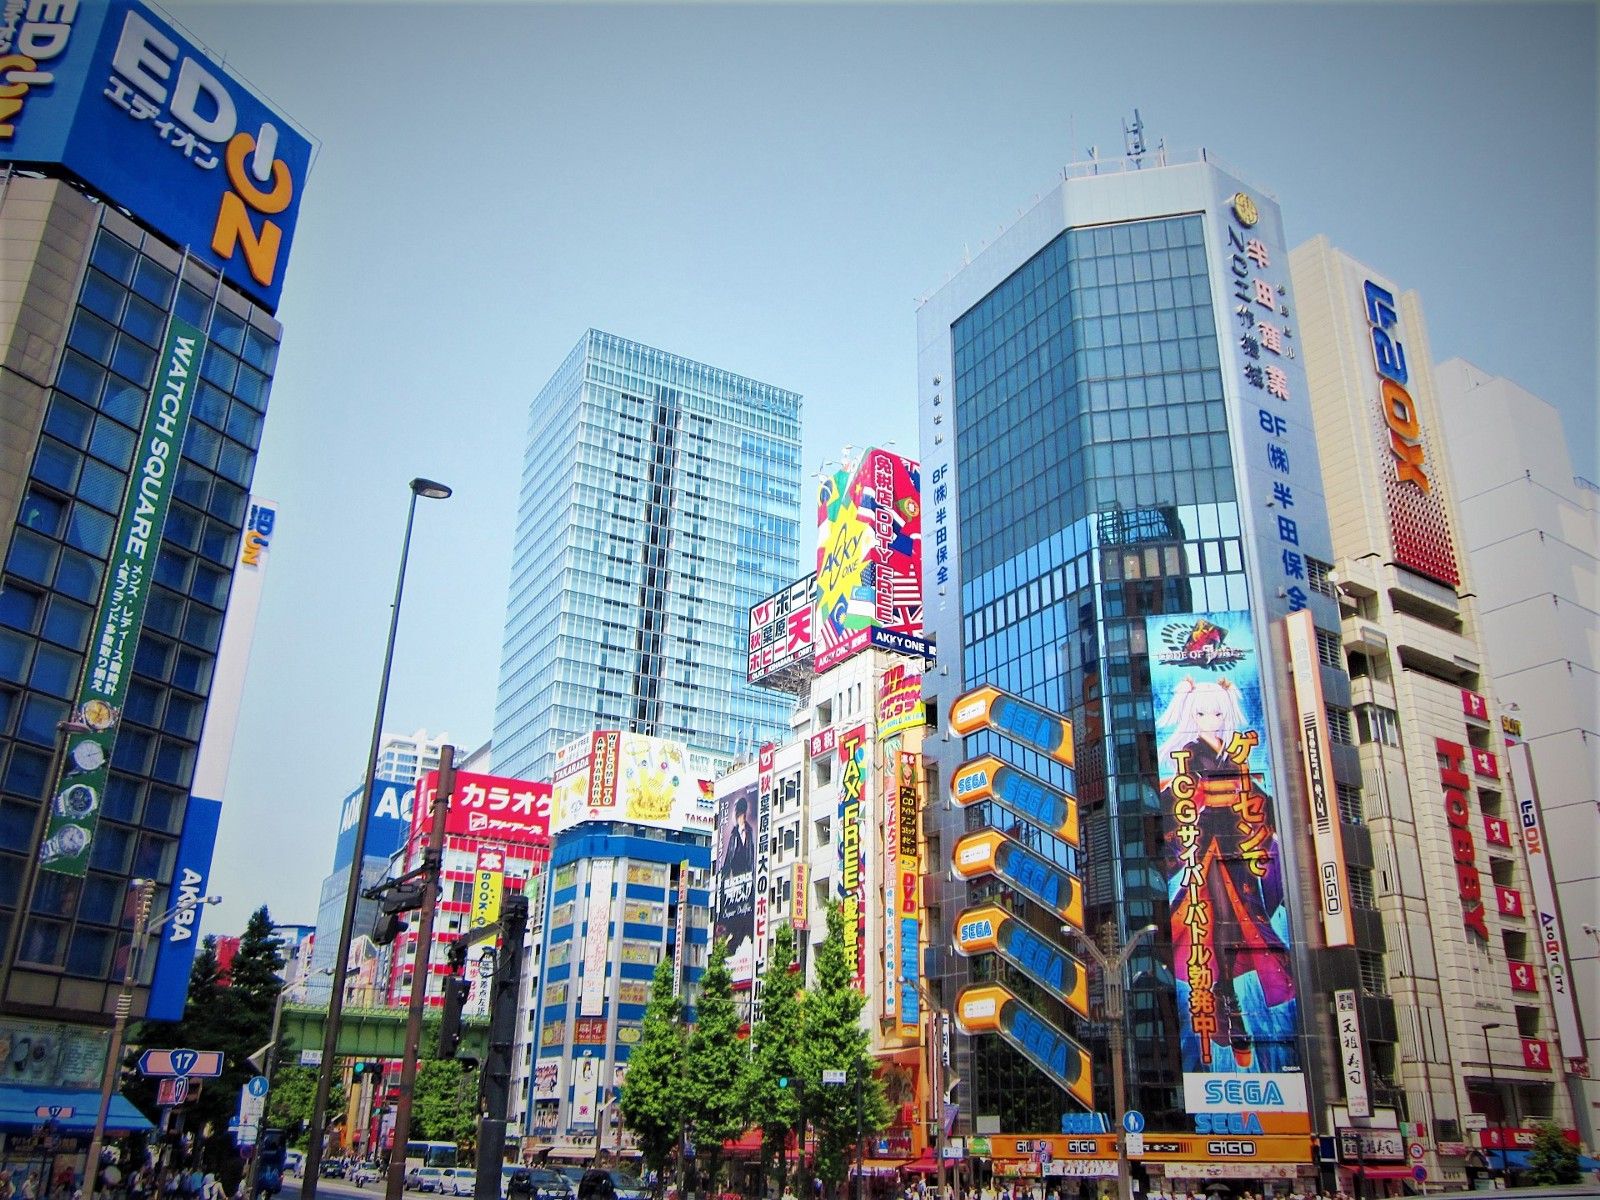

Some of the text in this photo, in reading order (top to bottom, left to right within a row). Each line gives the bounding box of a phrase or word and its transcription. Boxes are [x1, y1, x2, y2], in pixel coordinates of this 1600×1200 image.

[104, 75, 219, 171] エディオン
[112, 9, 293, 287] EDION
[1247, 239, 1290, 401] 半田産業
[1258, 409, 1288, 437] 8F
[125, 335, 195, 561] WATCH SQUARE
[875, 454, 893, 508] 免税店
[932, 464, 948, 484] 8F
[242, 506, 275, 566] EDION
[875, 509, 894, 625] DUTY FREE
[751, 618, 786, 650] 秋葉原
[876, 631, 904, 648] AKKY
[904, 640, 925, 653] ONE
[1189, 650, 1204, 659] OF
[750, 645, 785, 671] ホビー
[811, 729, 834, 754] 免税
[1001, 702, 1050, 748] SEGA
[555, 757, 589, 779] TAKARADA
[593, 737, 604, 804] AKIHABARA
[606, 734, 616, 785] WELCOME
[843, 737, 860, 803] TAX
[957, 770, 988, 794] SEGA
[901, 817, 915, 826] アニメ
[902, 797, 914, 806] CD
[1004, 774, 1056, 828] SEGA
[1227, 729, 1268, 877] ゲーセンで
[480, 852, 502, 870] 本
[843, 803, 860, 890] FREE
[1436, 736, 1489, 942] HOBBY
[1005, 851, 1059, 907] SEGA
[1323, 862, 1341, 914] GiGO
[170, 867, 202, 942] AKIBA
[961, 921, 992, 941] SEGA
[1008, 928, 1063, 991] SEGA
[176, 1053, 193, 1070] 17
[1011, 1009, 1067, 1078] SEGA
[1342, 1019, 1361, 1085] 元祖寿司
[50, 1107, 60, 1116] 17
[175, 1081, 184, 1097] 17
[1204, 1079, 1284, 1106] SEGA
[1067, 1140, 1097, 1153] GiGO
[1195, 1112, 1265, 1136] SEGA
[1207, 1141, 1256, 1156] GiGO
